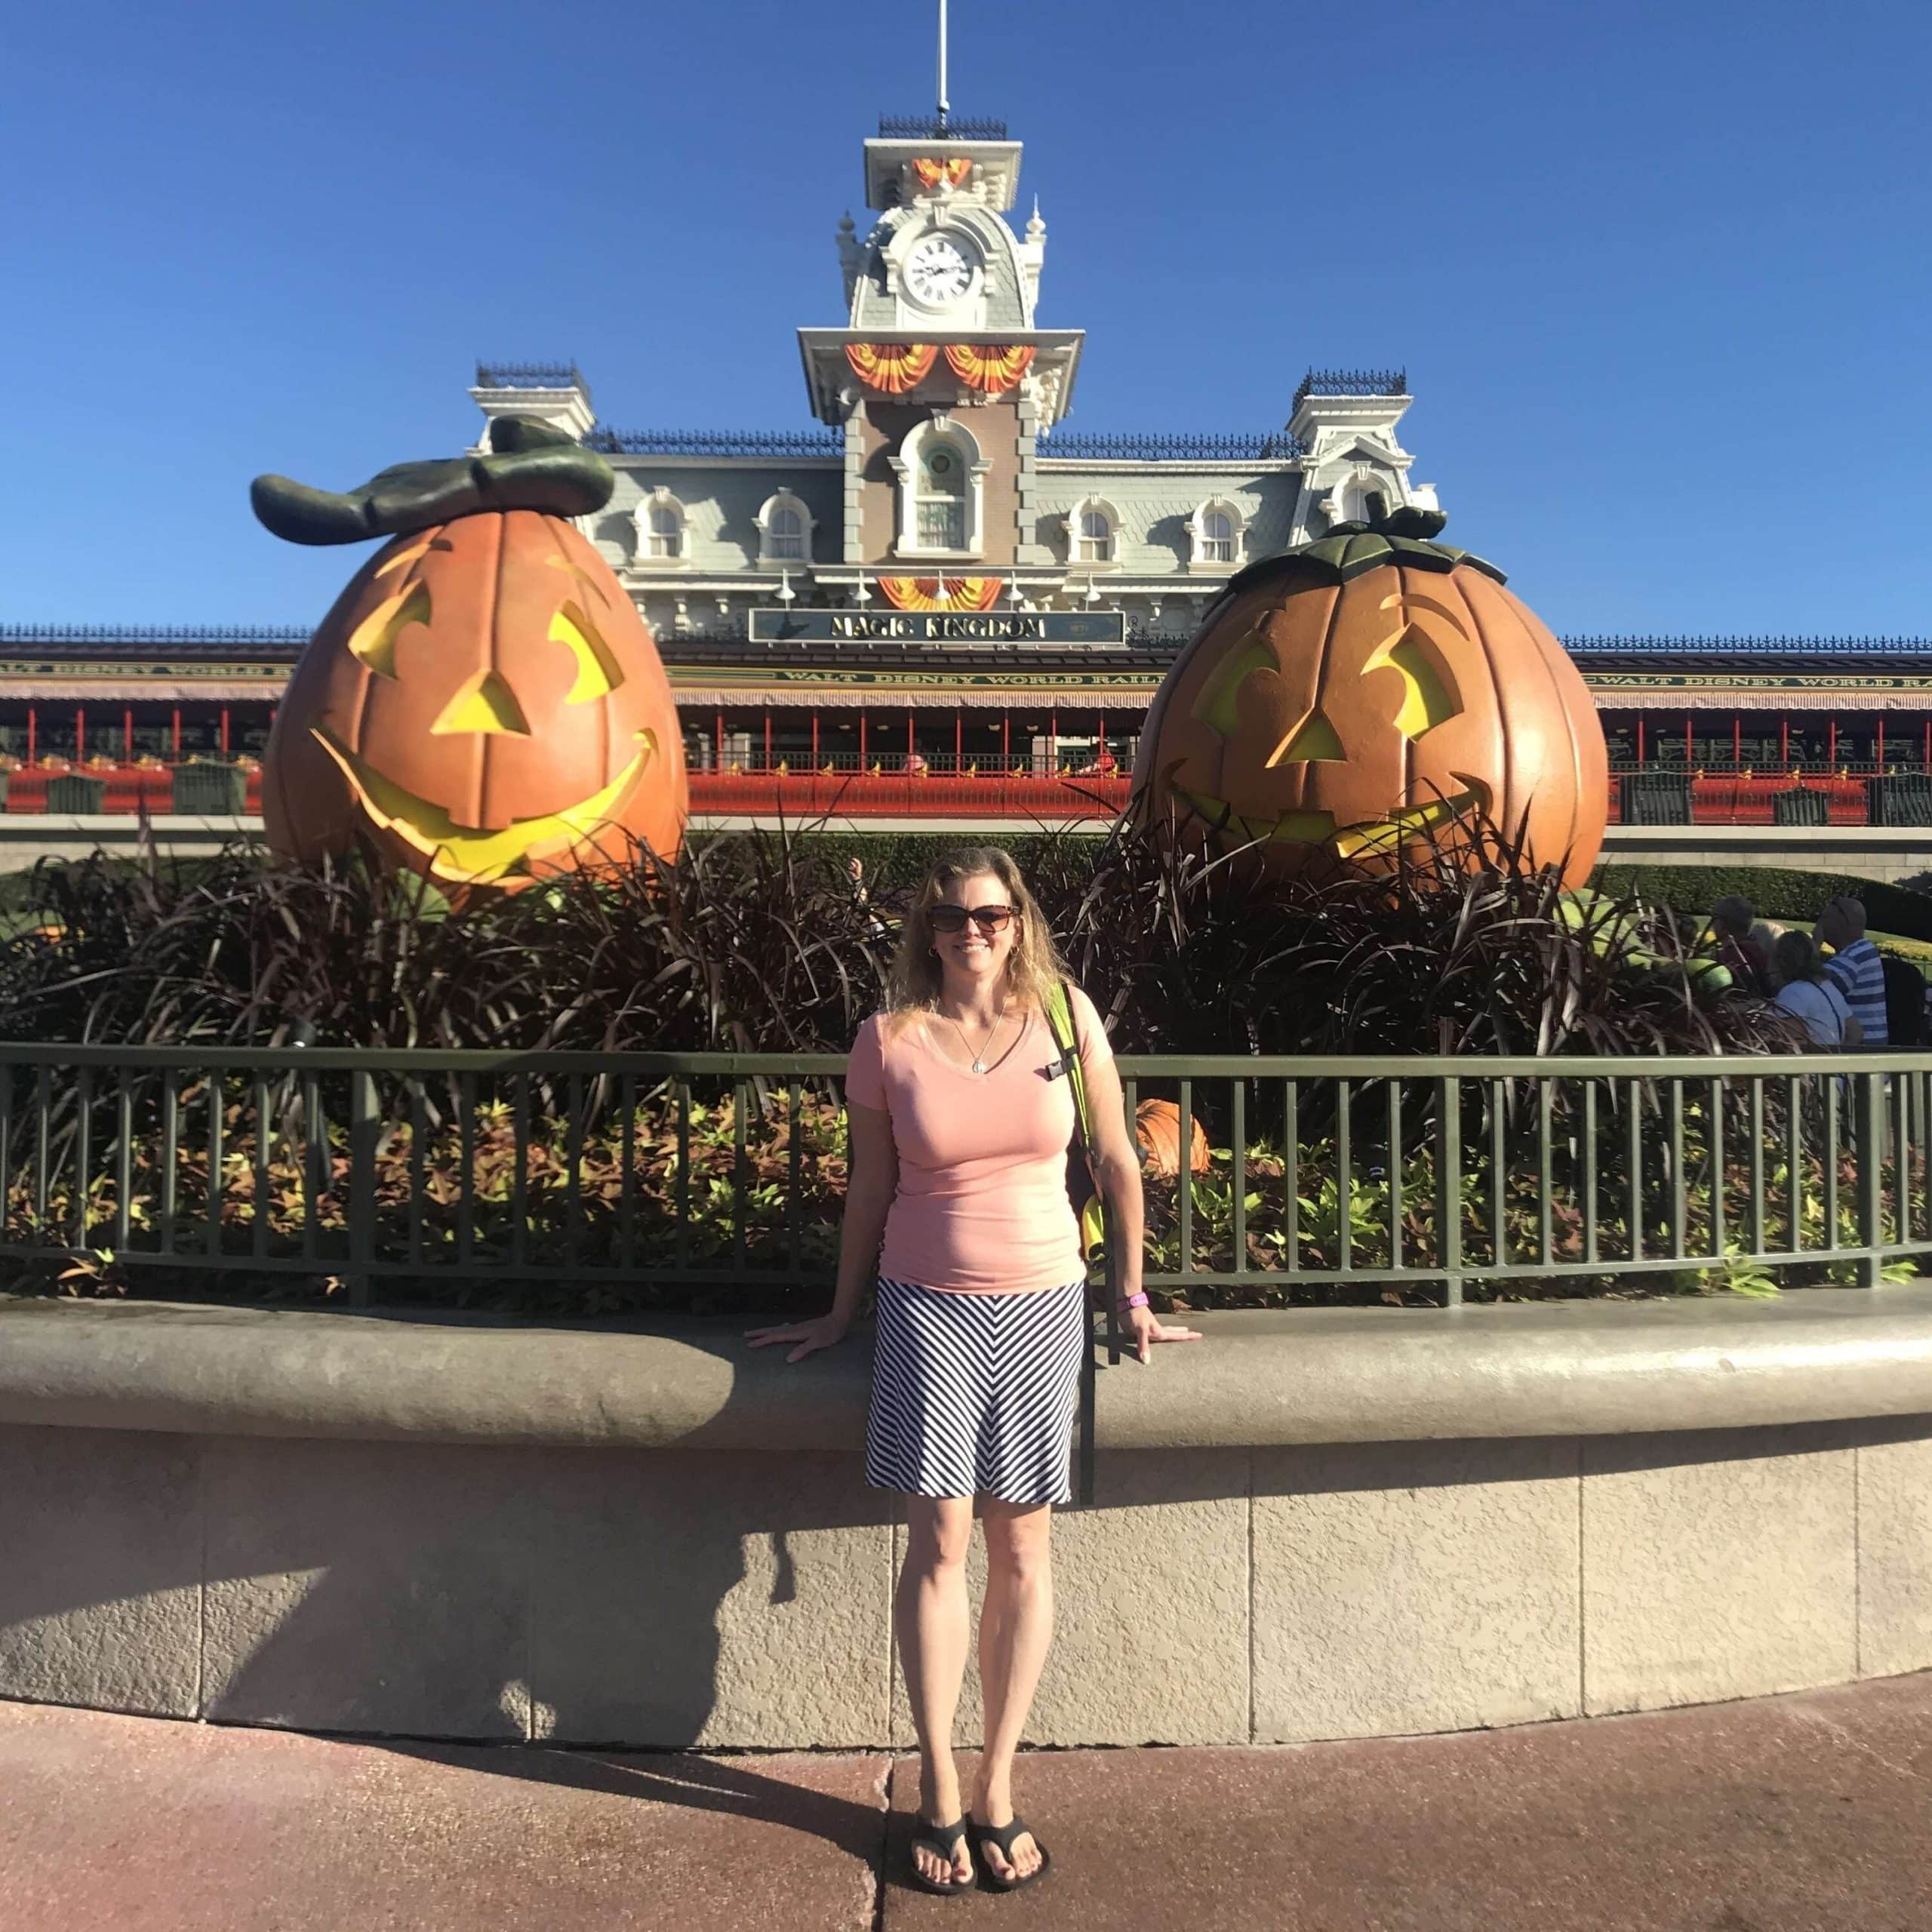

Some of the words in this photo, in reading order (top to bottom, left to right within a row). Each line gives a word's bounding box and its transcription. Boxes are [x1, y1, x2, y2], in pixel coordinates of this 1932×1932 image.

[831, 617, 914, 638] MAGIC
[925, 617, 1046, 638] KINGDOM
[784, 672, 857, 682] WALT
[875, 674, 975, 685] DISNEY
[986, 675, 1083, 685] WORLD
[1598, 676, 1672, 685] WALT
[1684, 678, 1786, 686] DISNEY
[1797, 678, 1893, 687] WORLD
